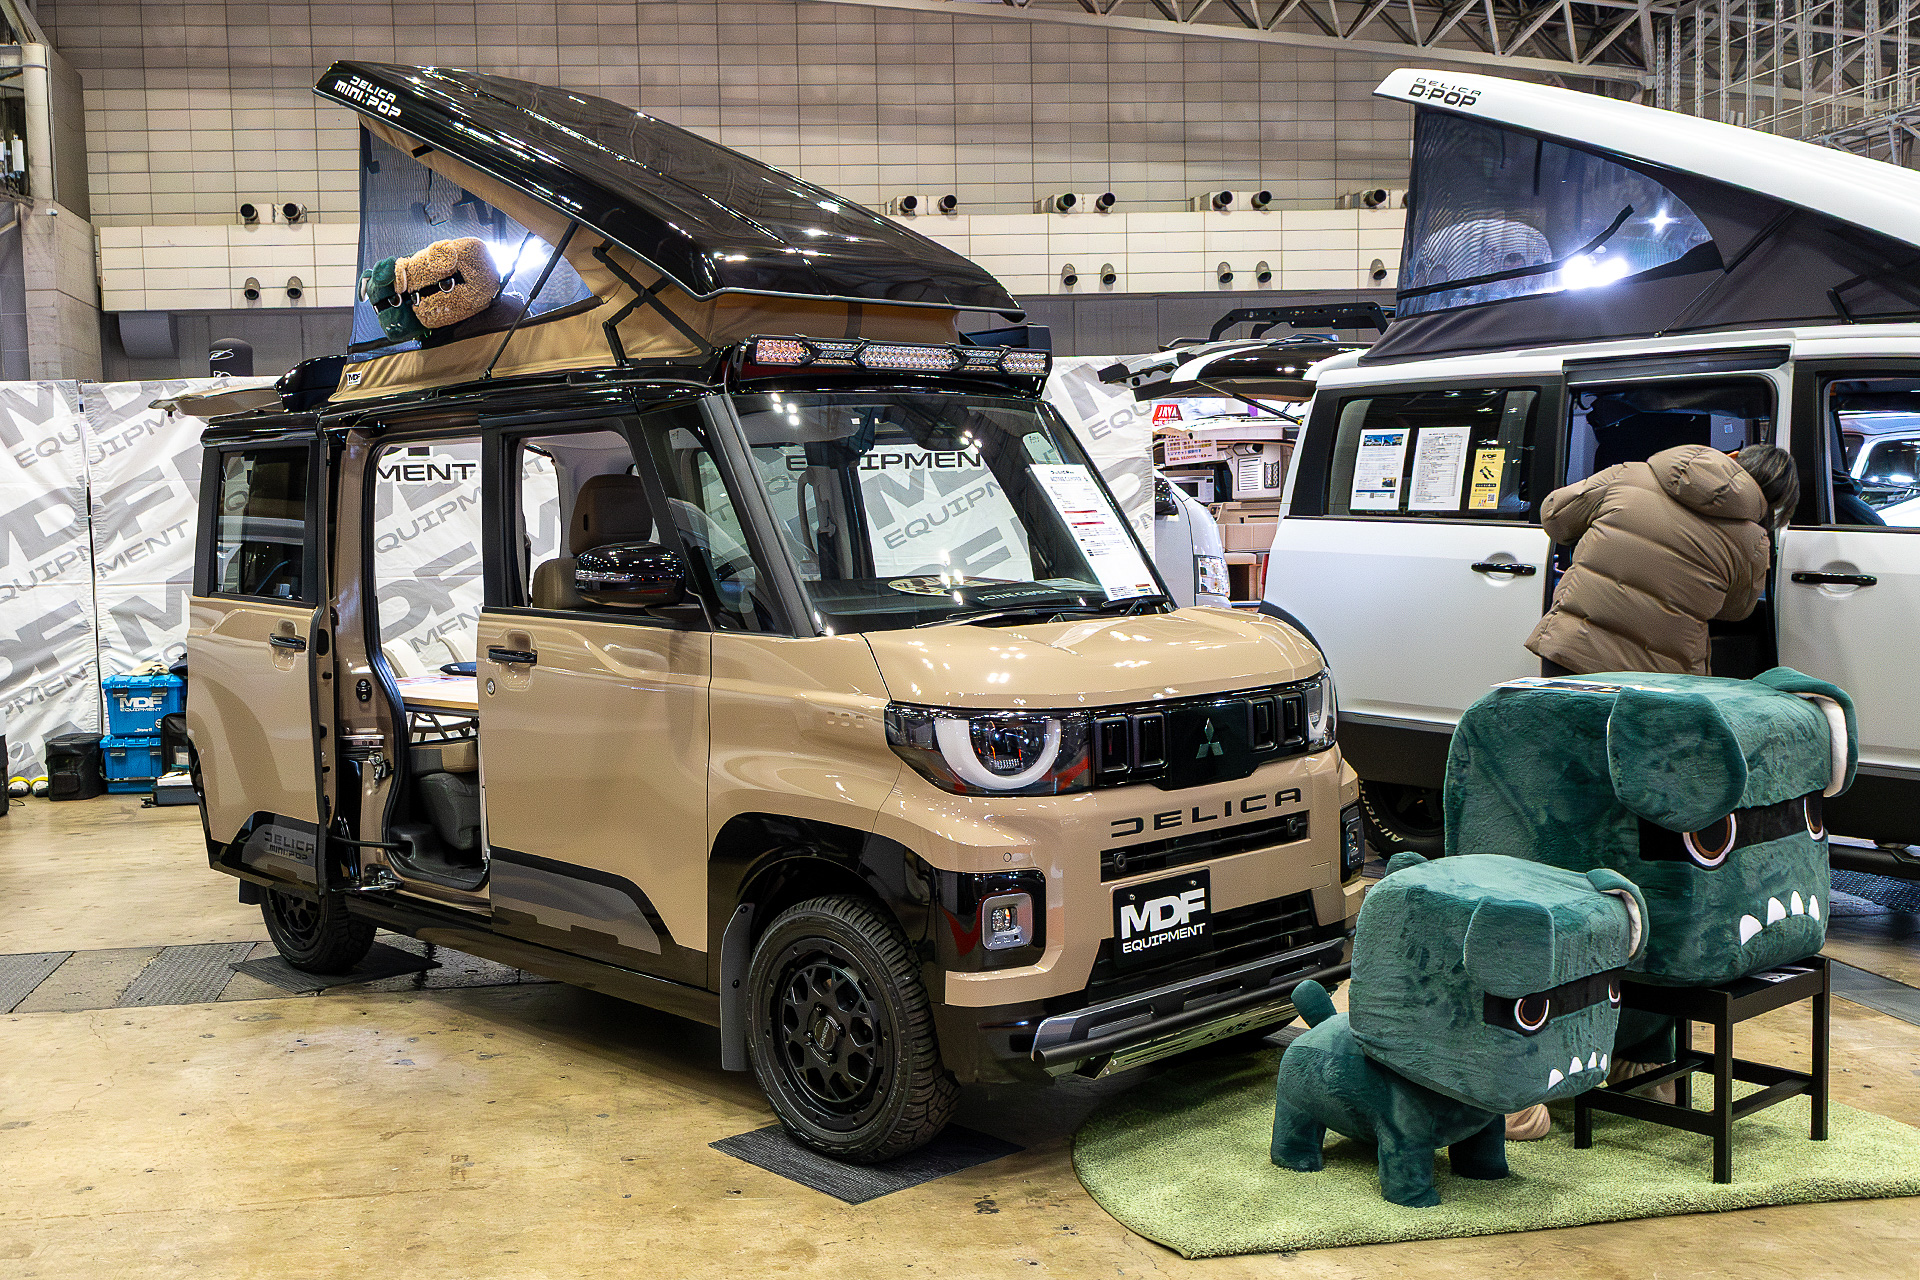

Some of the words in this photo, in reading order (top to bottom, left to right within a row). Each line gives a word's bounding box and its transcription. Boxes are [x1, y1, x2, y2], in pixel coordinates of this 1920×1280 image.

[350, 75, 397, 103] DELICA
[1408, 83, 1476, 107] D:POP
[1416, 77, 1482, 97] DELICA
[120, 697, 163, 708] MDF
[1111, 786, 1302, 839] DELICA
[264, 831, 315, 854] DELICA
[1120, 888, 1206, 940] MDF
[1122, 922, 1206, 954] EQUIPMENT
